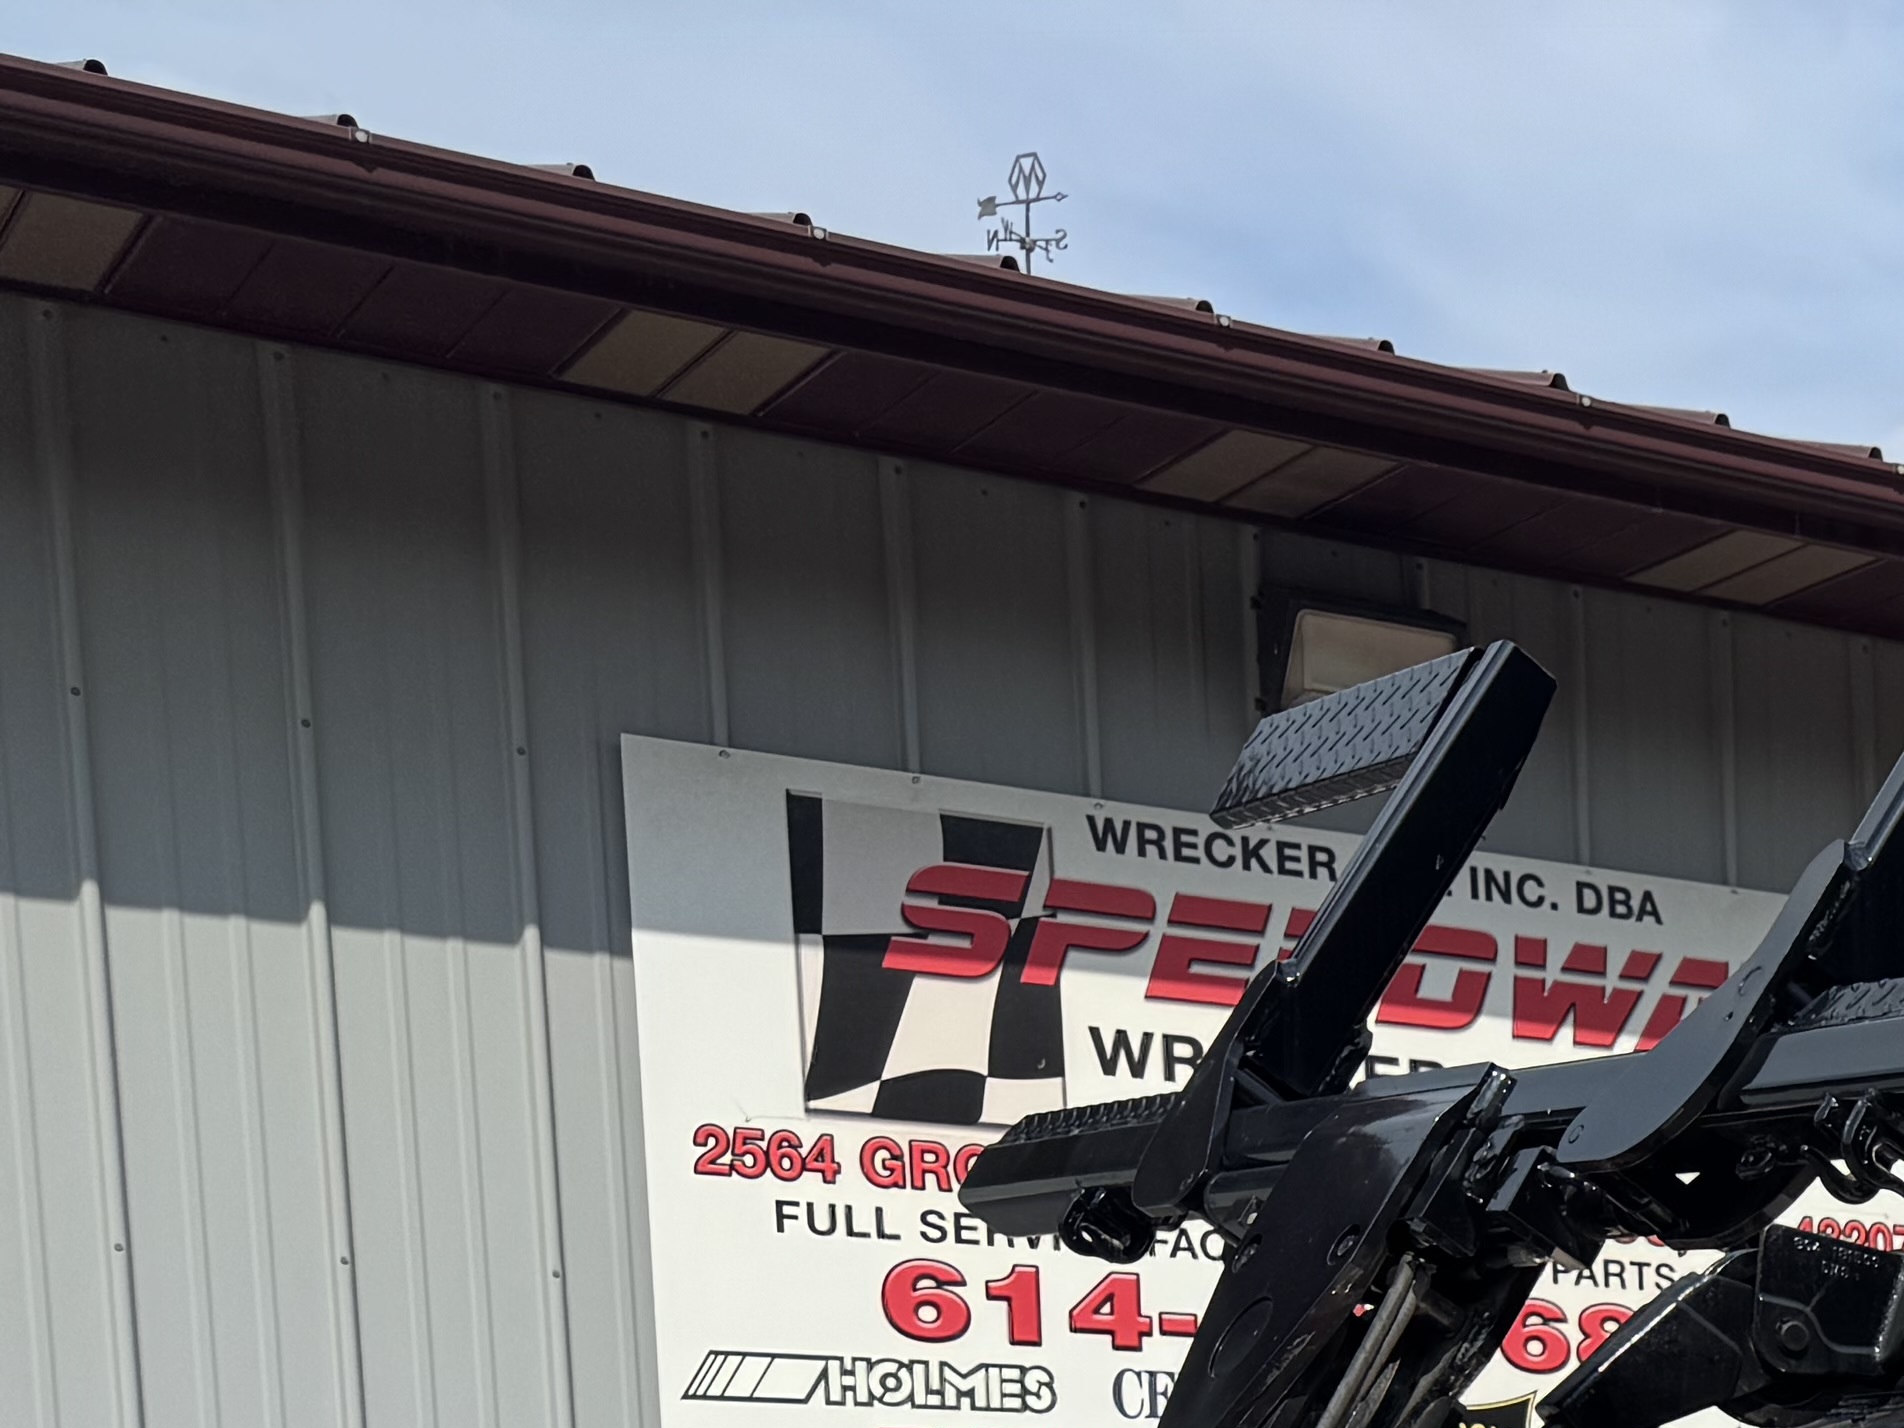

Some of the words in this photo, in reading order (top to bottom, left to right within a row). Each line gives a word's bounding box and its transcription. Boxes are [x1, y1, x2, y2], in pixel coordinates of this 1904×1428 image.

[1086, 814, 1337, 883] WRECKER
[1469, 866, 1559, 912] INC.
[1576, 881, 1664, 926] DBA
[693, 1123, 841, 1185] 2564
[775, 1200, 901, 1241] FULL
[822, 1356, 1058, 1413] HOLMES
